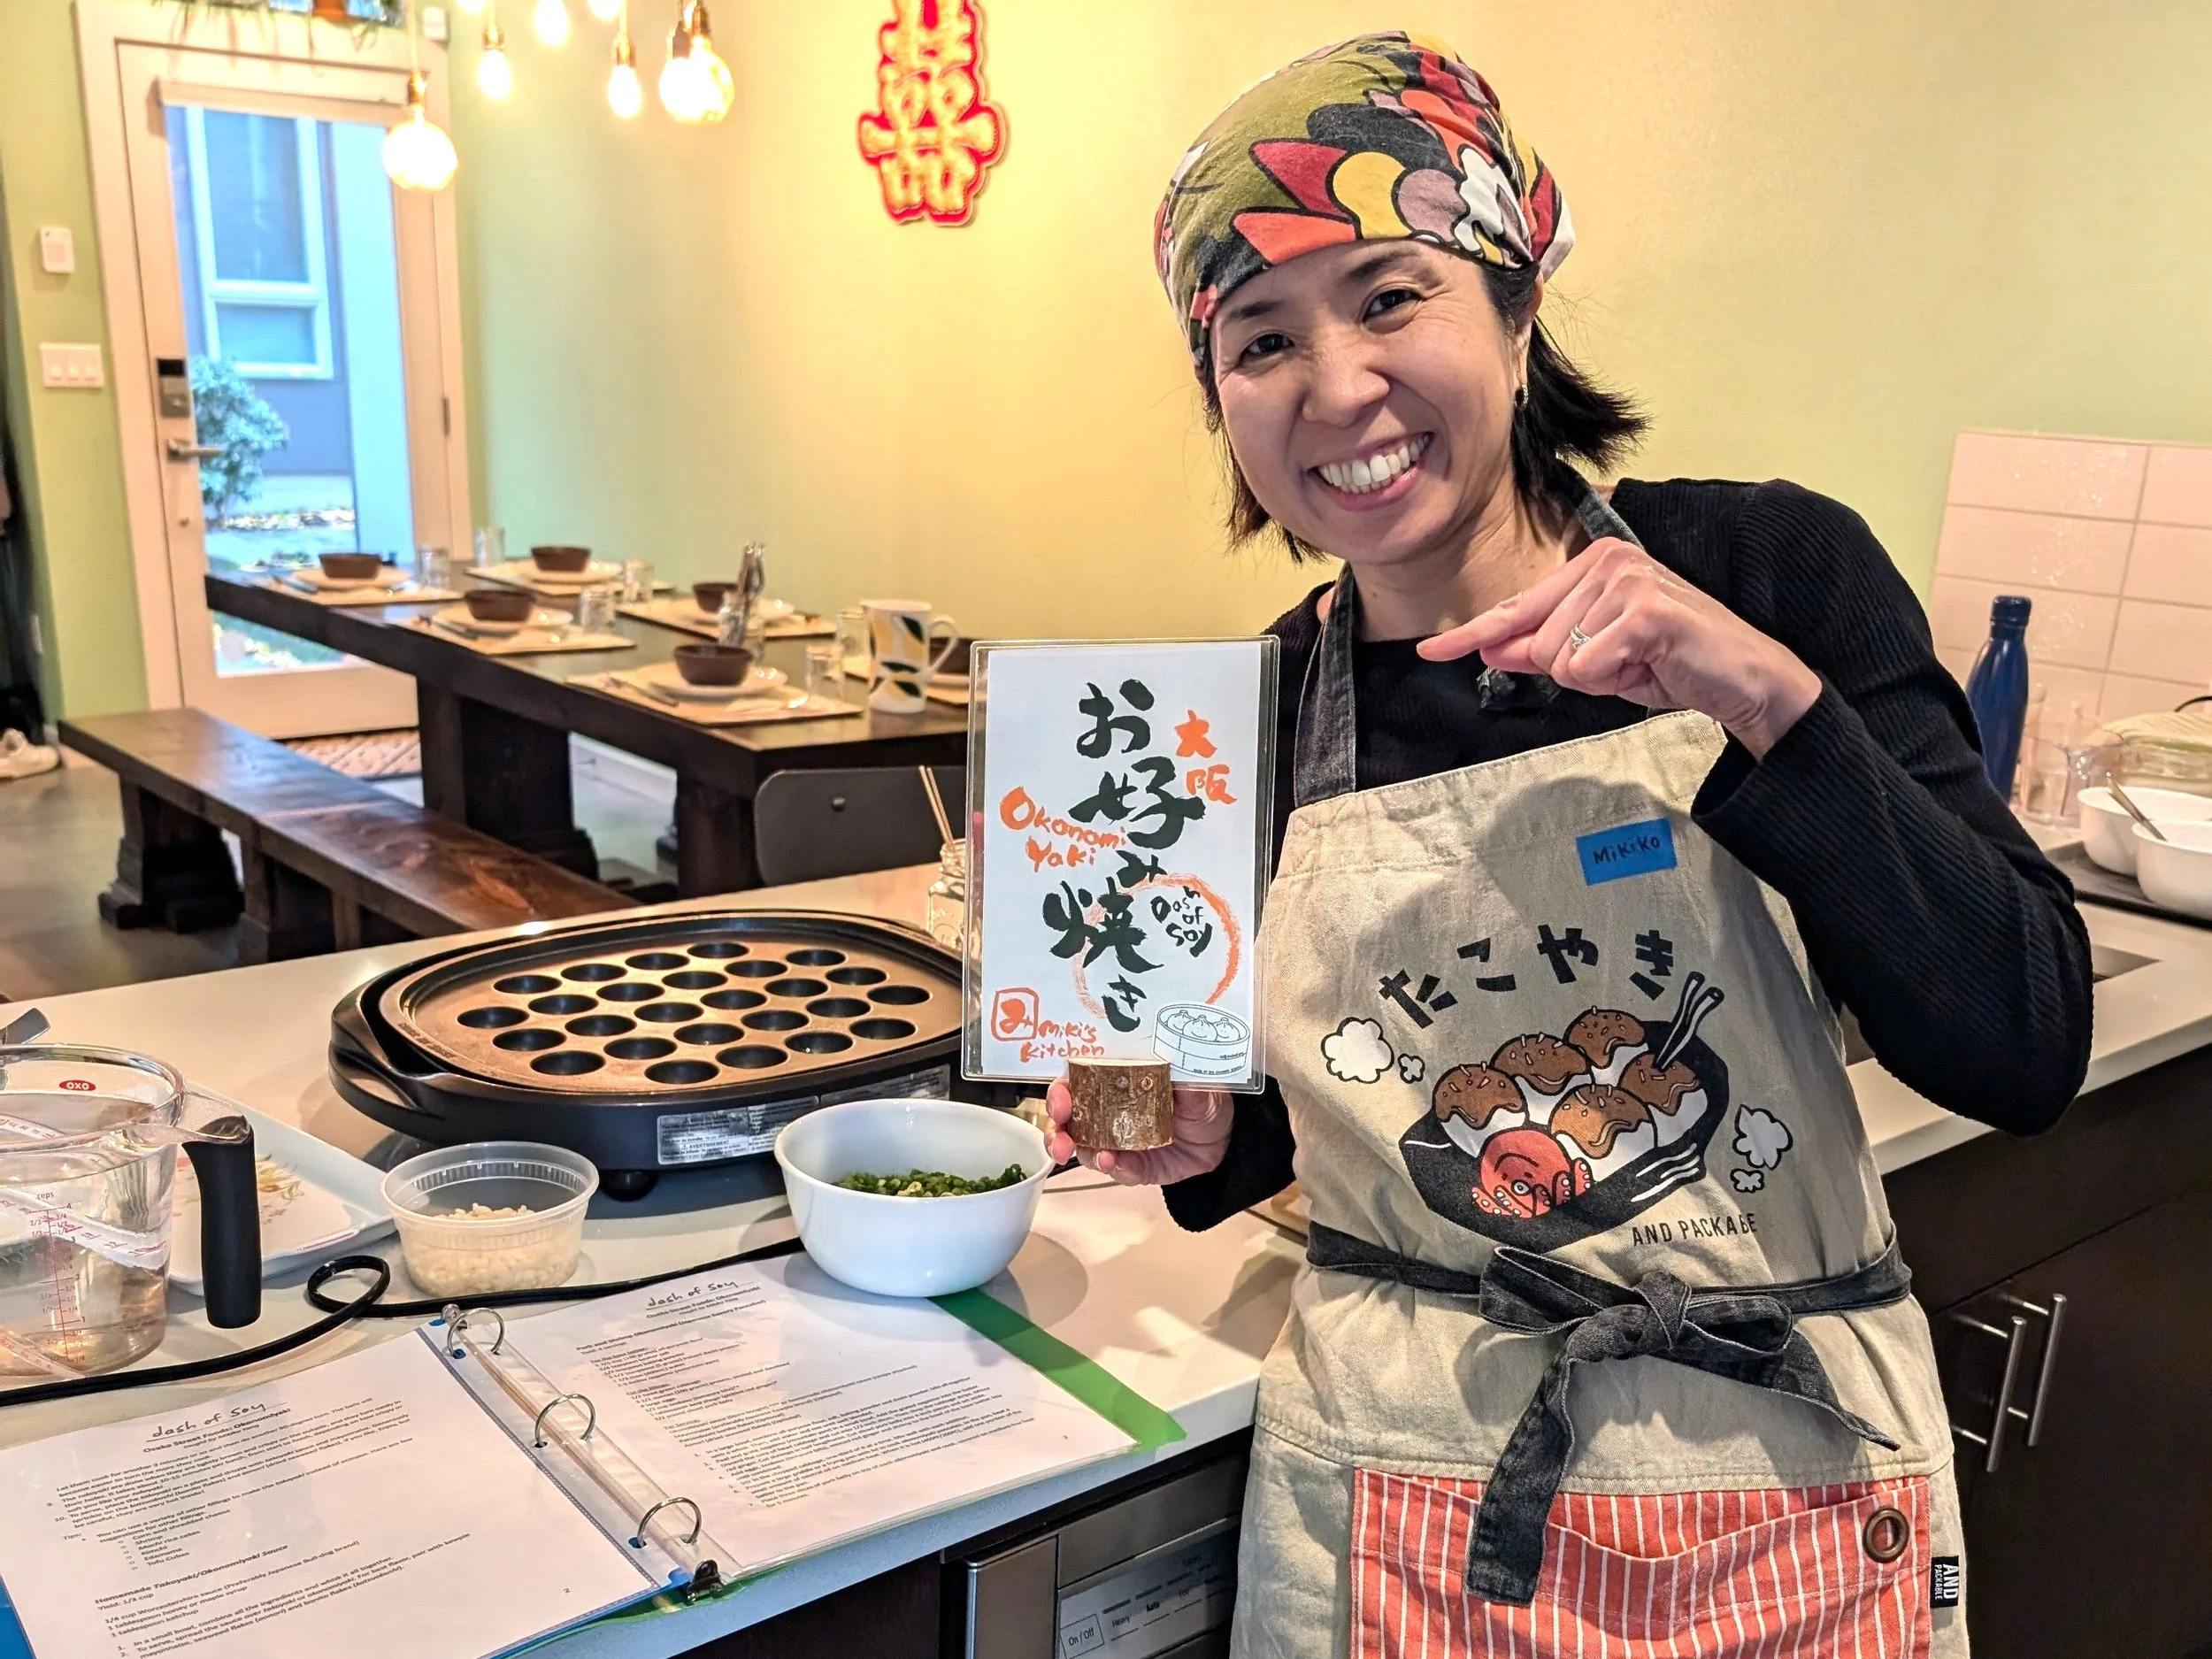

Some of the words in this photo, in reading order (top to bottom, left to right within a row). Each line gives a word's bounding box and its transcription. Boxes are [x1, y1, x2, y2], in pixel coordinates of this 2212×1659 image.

[1174, 710, 1238, 805] 大阪
[1000, 786, 1128, 849] Okonomi
[1025, 835, 1095, 872] Yaki
[1042, 679, 1206, 1033] お好み焼き
[1182, 906, 1204, 925] of
[1379, 924, 1674, 1029] たこやき
[66, 1082, 90, 1091] OXO
[1632, 1222, 1672, 1247] AND
[647, 1292, 683, 1307] dash
[687, 1286, 702, 1296] of
[143, 1444, 171, 1452] Osaka
[173, 1436, 201, 1445] Street
[202, 1427, 232, 1438] Foods:
[233, 1408, 290, 1428] Okonomiyaki
[152, 1421, 196, 1438] dash
[204, 1413, 223, 1425] of
[95, 1586, 151, 1603] Homemade
[154, 1553, 259, 1587] Takoyaki/Okonomiyaki
[262, 1545, 287, 1556] Sauce
[137, 1595, 198, 1614] Worcestershire
[200, 1587, 222, 1596] sauce
[223, 1573, 266, 1589] (Preferably
[267, 1561, 301, 1575] Japanese
[334, 1540, 359, 1552] brand)
[1935, 1564, 1943, 1600] PACKABLE
[1943, 1564, 1959, 1599] AND
[97, 1602, 120, 1610] Yield:
[115, 1613, 161, 1628] tablespoon
[162, 1605, 187, 1615] honey
[199, 1594, 224, 1603] maple
[225, 1586, 247, 1595] syrup
[118, 1620, 164, 1634] tablespoon
[165, 1609, 198, 1621] ketchup
[1068, 1634, 1079, 1645] On
[1083, 1628, 1094, 1640] Off
